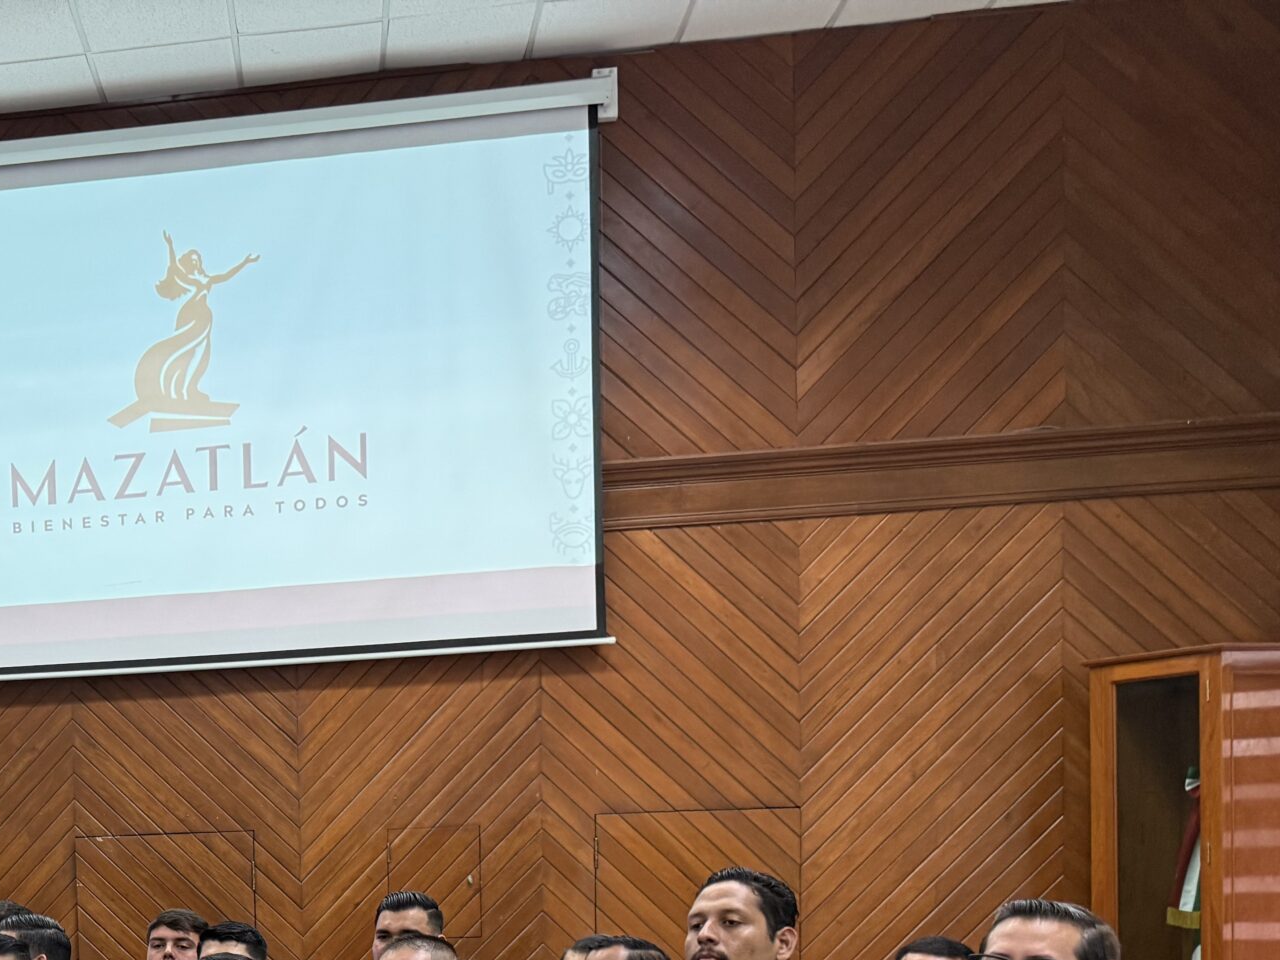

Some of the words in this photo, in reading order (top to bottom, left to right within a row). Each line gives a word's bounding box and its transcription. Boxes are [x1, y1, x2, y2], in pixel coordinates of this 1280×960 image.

[10, 425, 368, 508] MAZATLÁN
[12, 510, 165, 534] BIENESTAR
[185, 504, 255, 520] PARA
[274, 494, 368, 514] TODOS
